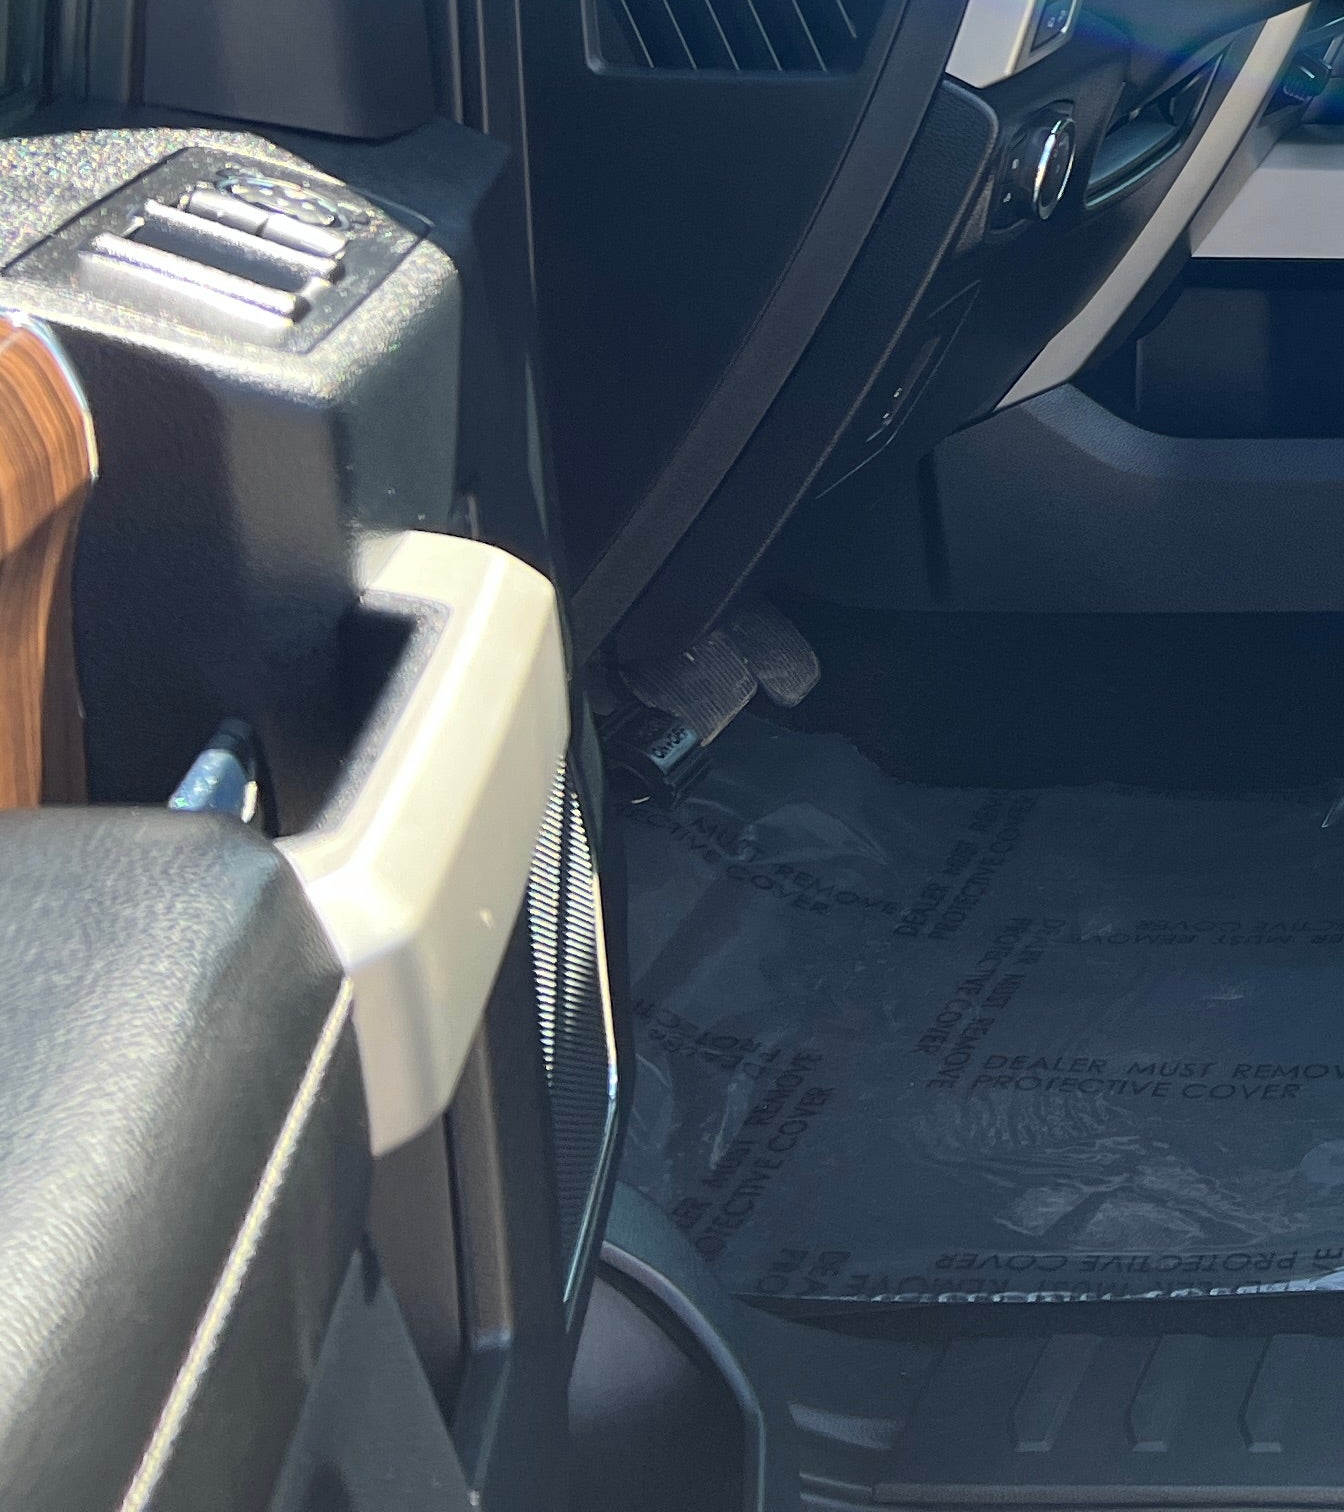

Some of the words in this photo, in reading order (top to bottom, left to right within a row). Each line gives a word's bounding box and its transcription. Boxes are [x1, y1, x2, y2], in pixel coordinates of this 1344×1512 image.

[982, 1053, 1108, 1074] DEALER
[1126, 1061, 1216, 1079] MUST
[970, 1074, 1173, 1099] PROTECTIVE
[1180, 1081, 1303, 1101] COVER
[694, 1159, 785, 1262] OTECTIVE
[767, 1086, 836, 1153] COVER
[934, 1252, 1068, 1272] COVER
[1080, 1251, 1298, 1273] PROTECTIVE
